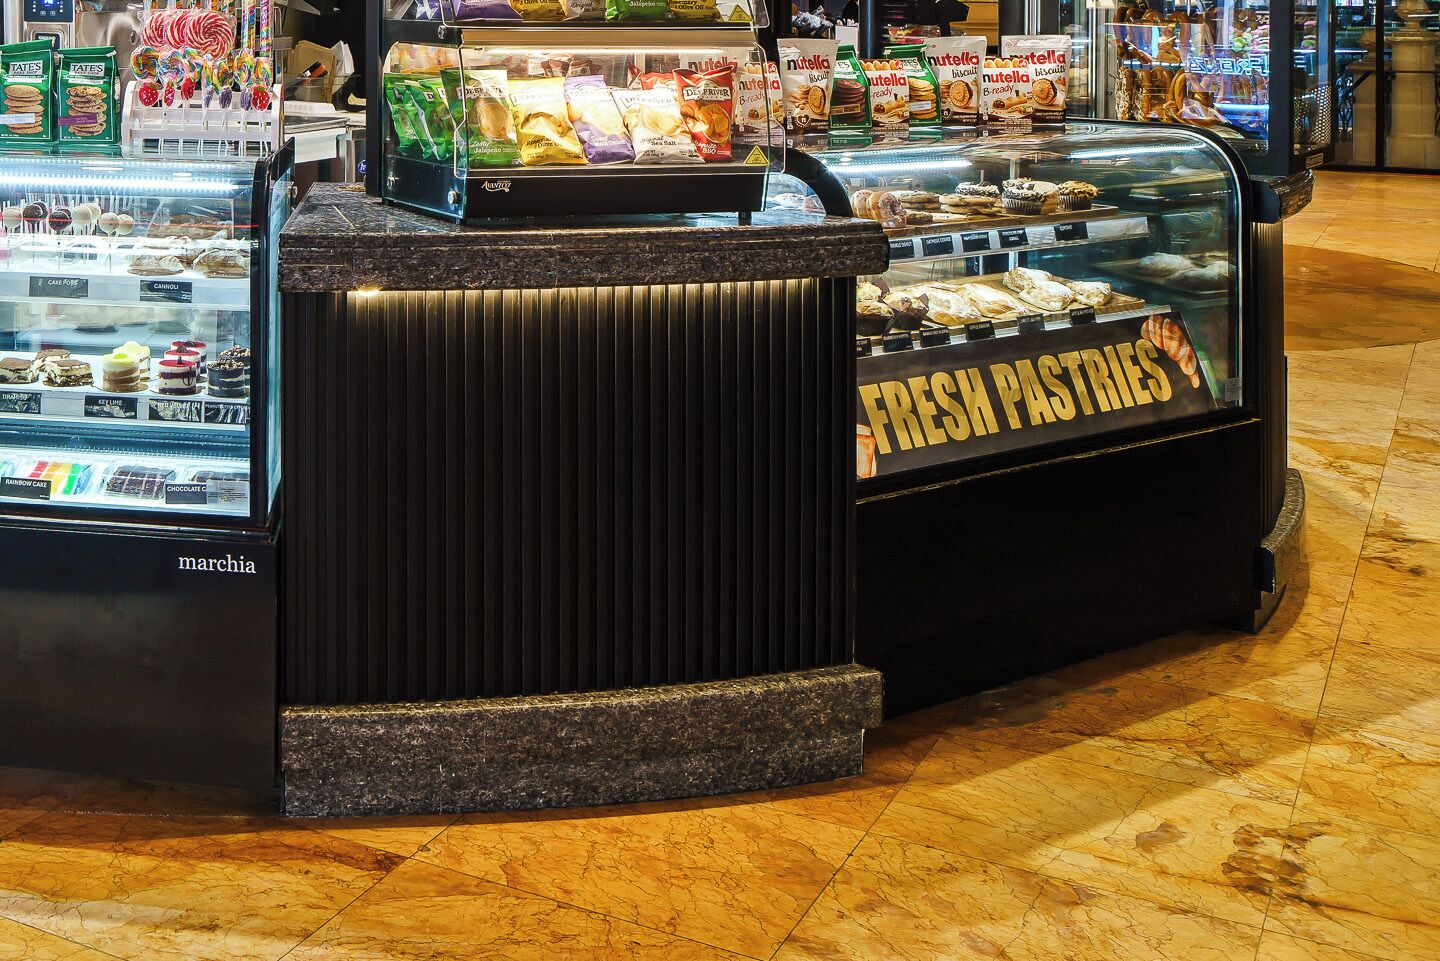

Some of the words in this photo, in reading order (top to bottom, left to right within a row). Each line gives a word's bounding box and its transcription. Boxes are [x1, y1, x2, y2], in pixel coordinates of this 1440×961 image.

[571, 1, 593, 9] Original
[787, 55, 831, 71] nutella
[927, 52, 979, 67] nutella
[10, 62, 41, 72] TATE'S
[71, 63, 103, 73] TATE'S
[1035, 65, 1066, 77] biscuits
[983, 71, 1030, 83] nutella
[708, 88, 731, 97] RIVER
[983, 84, 1014, 97] B-ready
[858, 367, 1000, 455] FRESH
[990, 339, 1172, 430] PASTRIES
[6, 479, 31, 487] RAINBOW
[32, 480, 47, 488] CAKE
[179, 554, 257, 574] marchia
